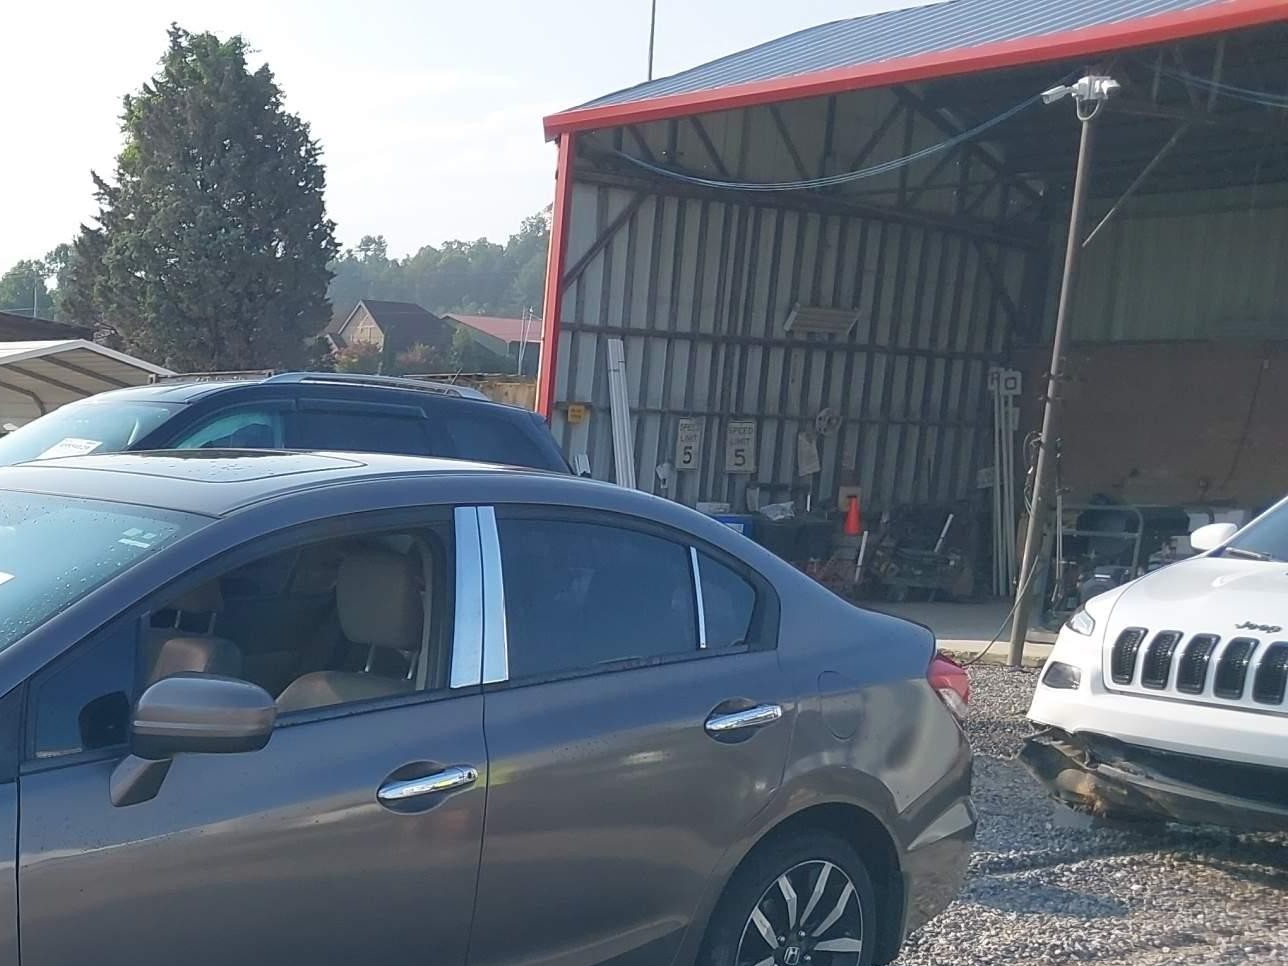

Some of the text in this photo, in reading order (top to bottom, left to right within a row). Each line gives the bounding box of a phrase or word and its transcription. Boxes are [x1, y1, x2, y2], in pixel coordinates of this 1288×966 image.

[728, 426, 753, 434] SPEED
[682, 446, 693, 464] 5
[734, 449, 746, 466] 5
[1234, 621, 1283, 634] Jeep
